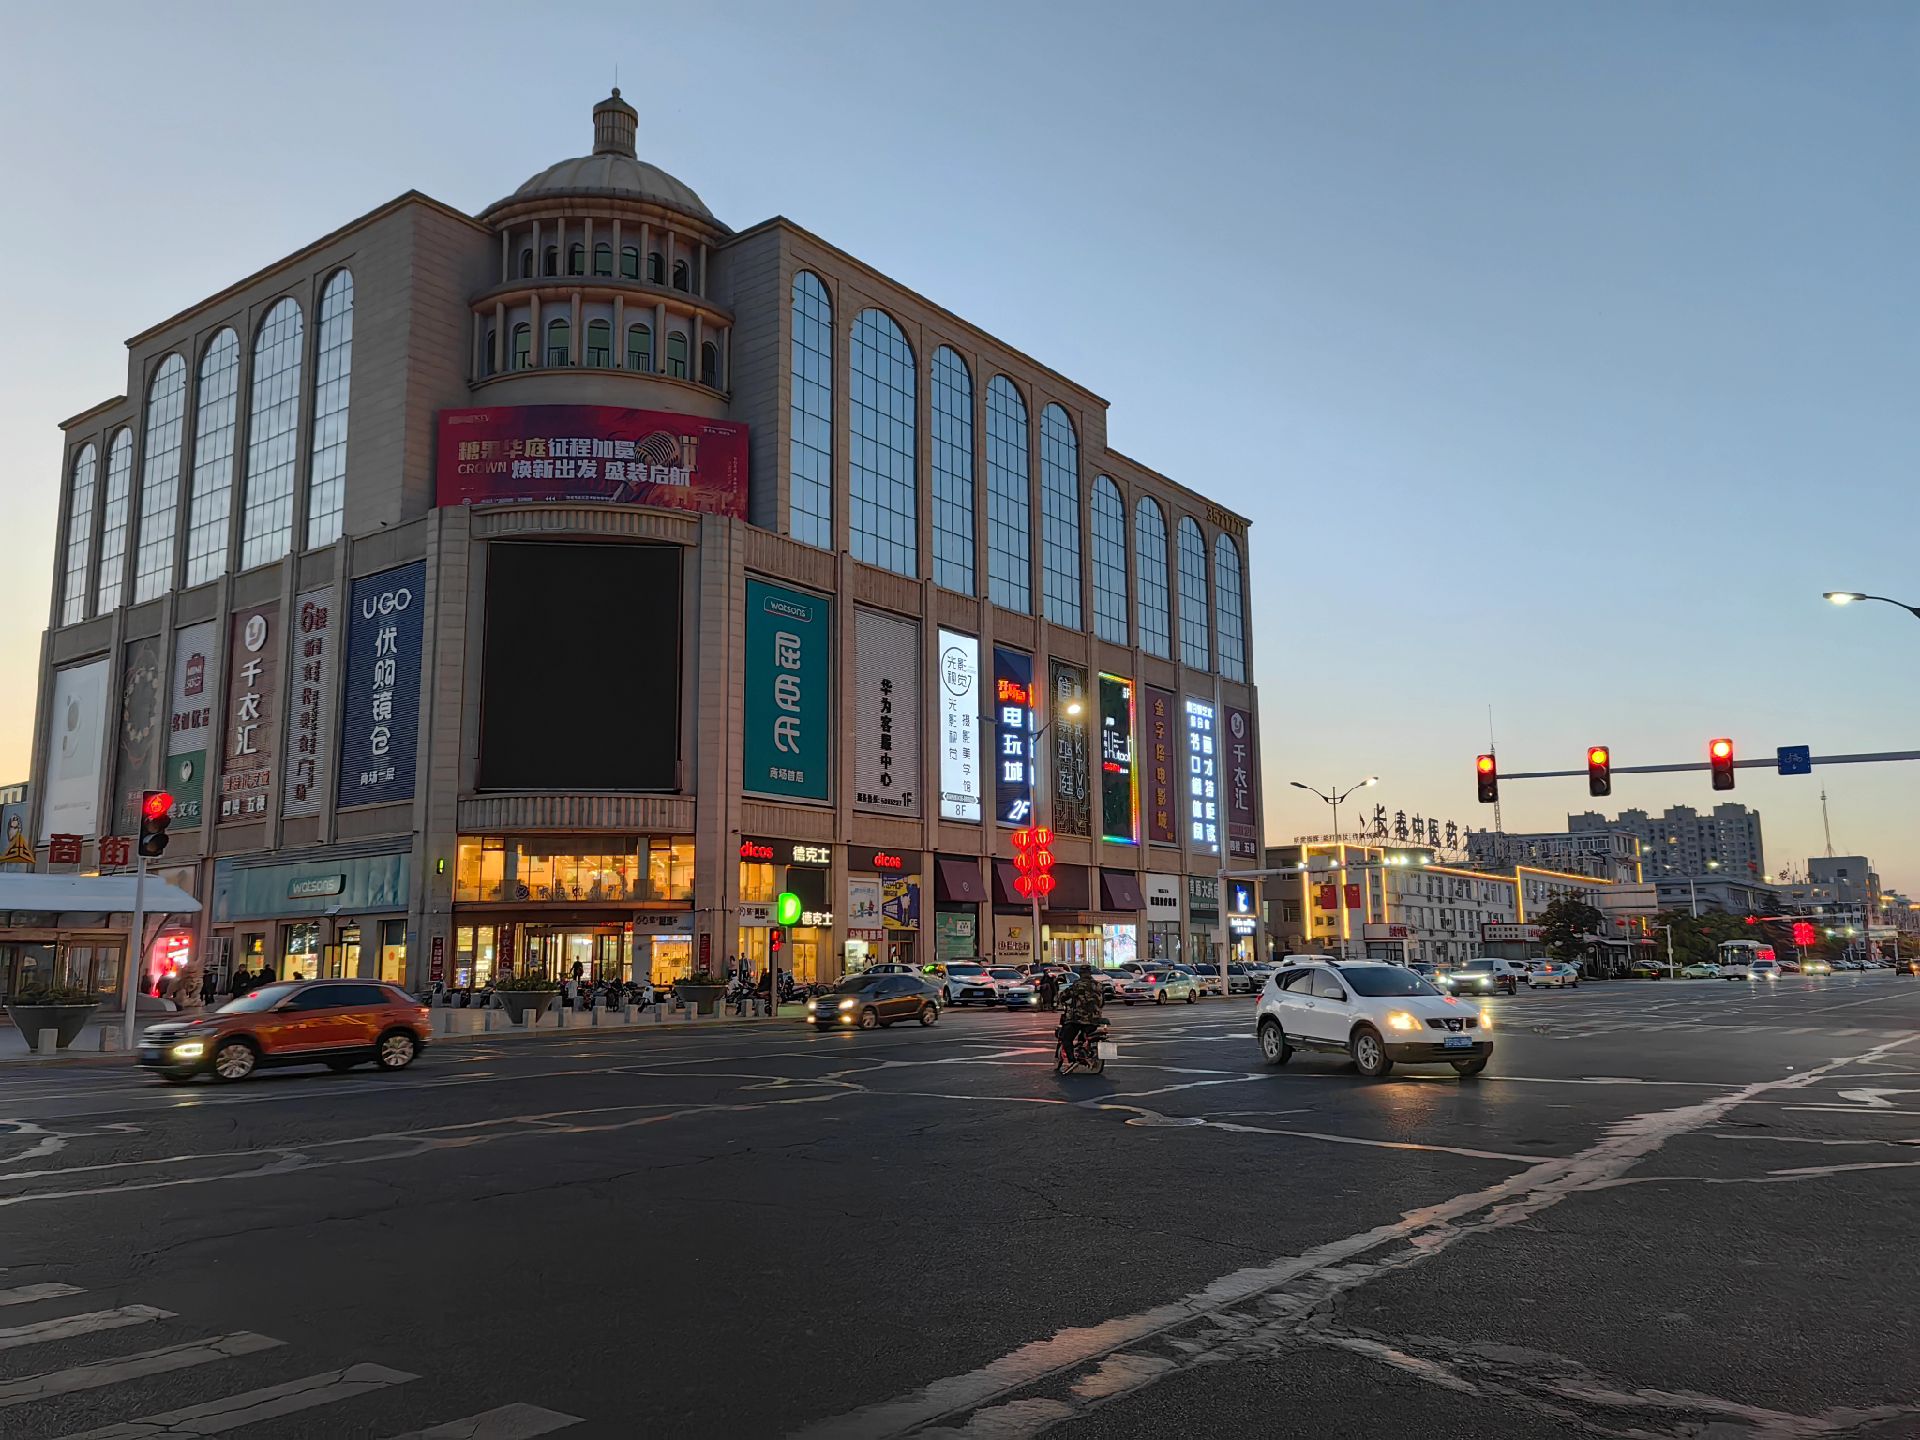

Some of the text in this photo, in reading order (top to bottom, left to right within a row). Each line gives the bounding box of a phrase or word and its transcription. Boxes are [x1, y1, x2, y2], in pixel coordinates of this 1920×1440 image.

[511, 459, 691, 487] 焕新出发 盛装启航
[363, 588, 413, 619] UGO
[369, 626, 398, 756] 优购镜仓
[774, 631, 801, 755] 屈臣氏
[235, 657, 263, 755] 千衣汇
[1003, 706, 1023, 782] 电玩城
[1233, 744, 1249, 811] 千衣汇
[955, 804, 967, 817] 8F
[1008, 800, 1031, 820] 2F
[740, 841, 774, 859] dicos
[793, 845, 830, 864] 德克士
[873, 852, 903, 869] dicos
[293, 880, 335, 894] watsons
[802, 911, 834, 926] 德克士
